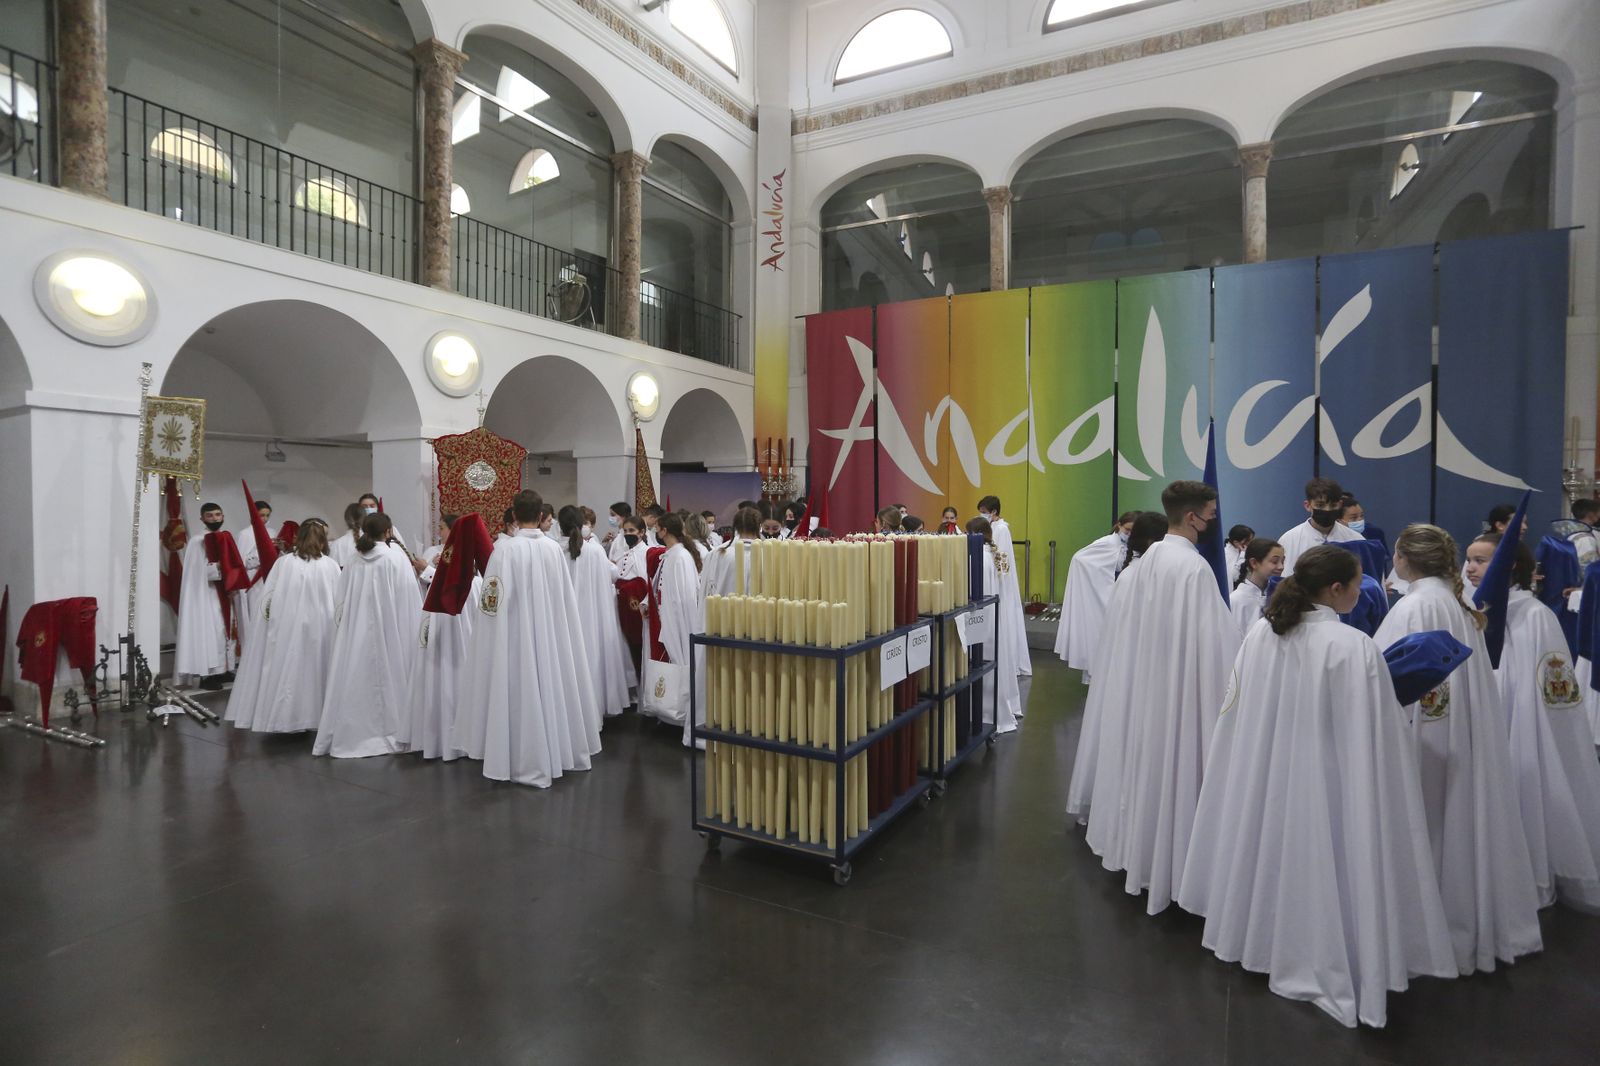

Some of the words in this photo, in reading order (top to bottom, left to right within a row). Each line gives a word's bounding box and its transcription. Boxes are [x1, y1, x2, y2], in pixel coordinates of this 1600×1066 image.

[760, 168, 786, 271] Andalucía
[817, 283, 1544, 496] Andalucía
[886, 645, 902, 660] CIRIOS
[912, 634, 928, 647] CRISTO
